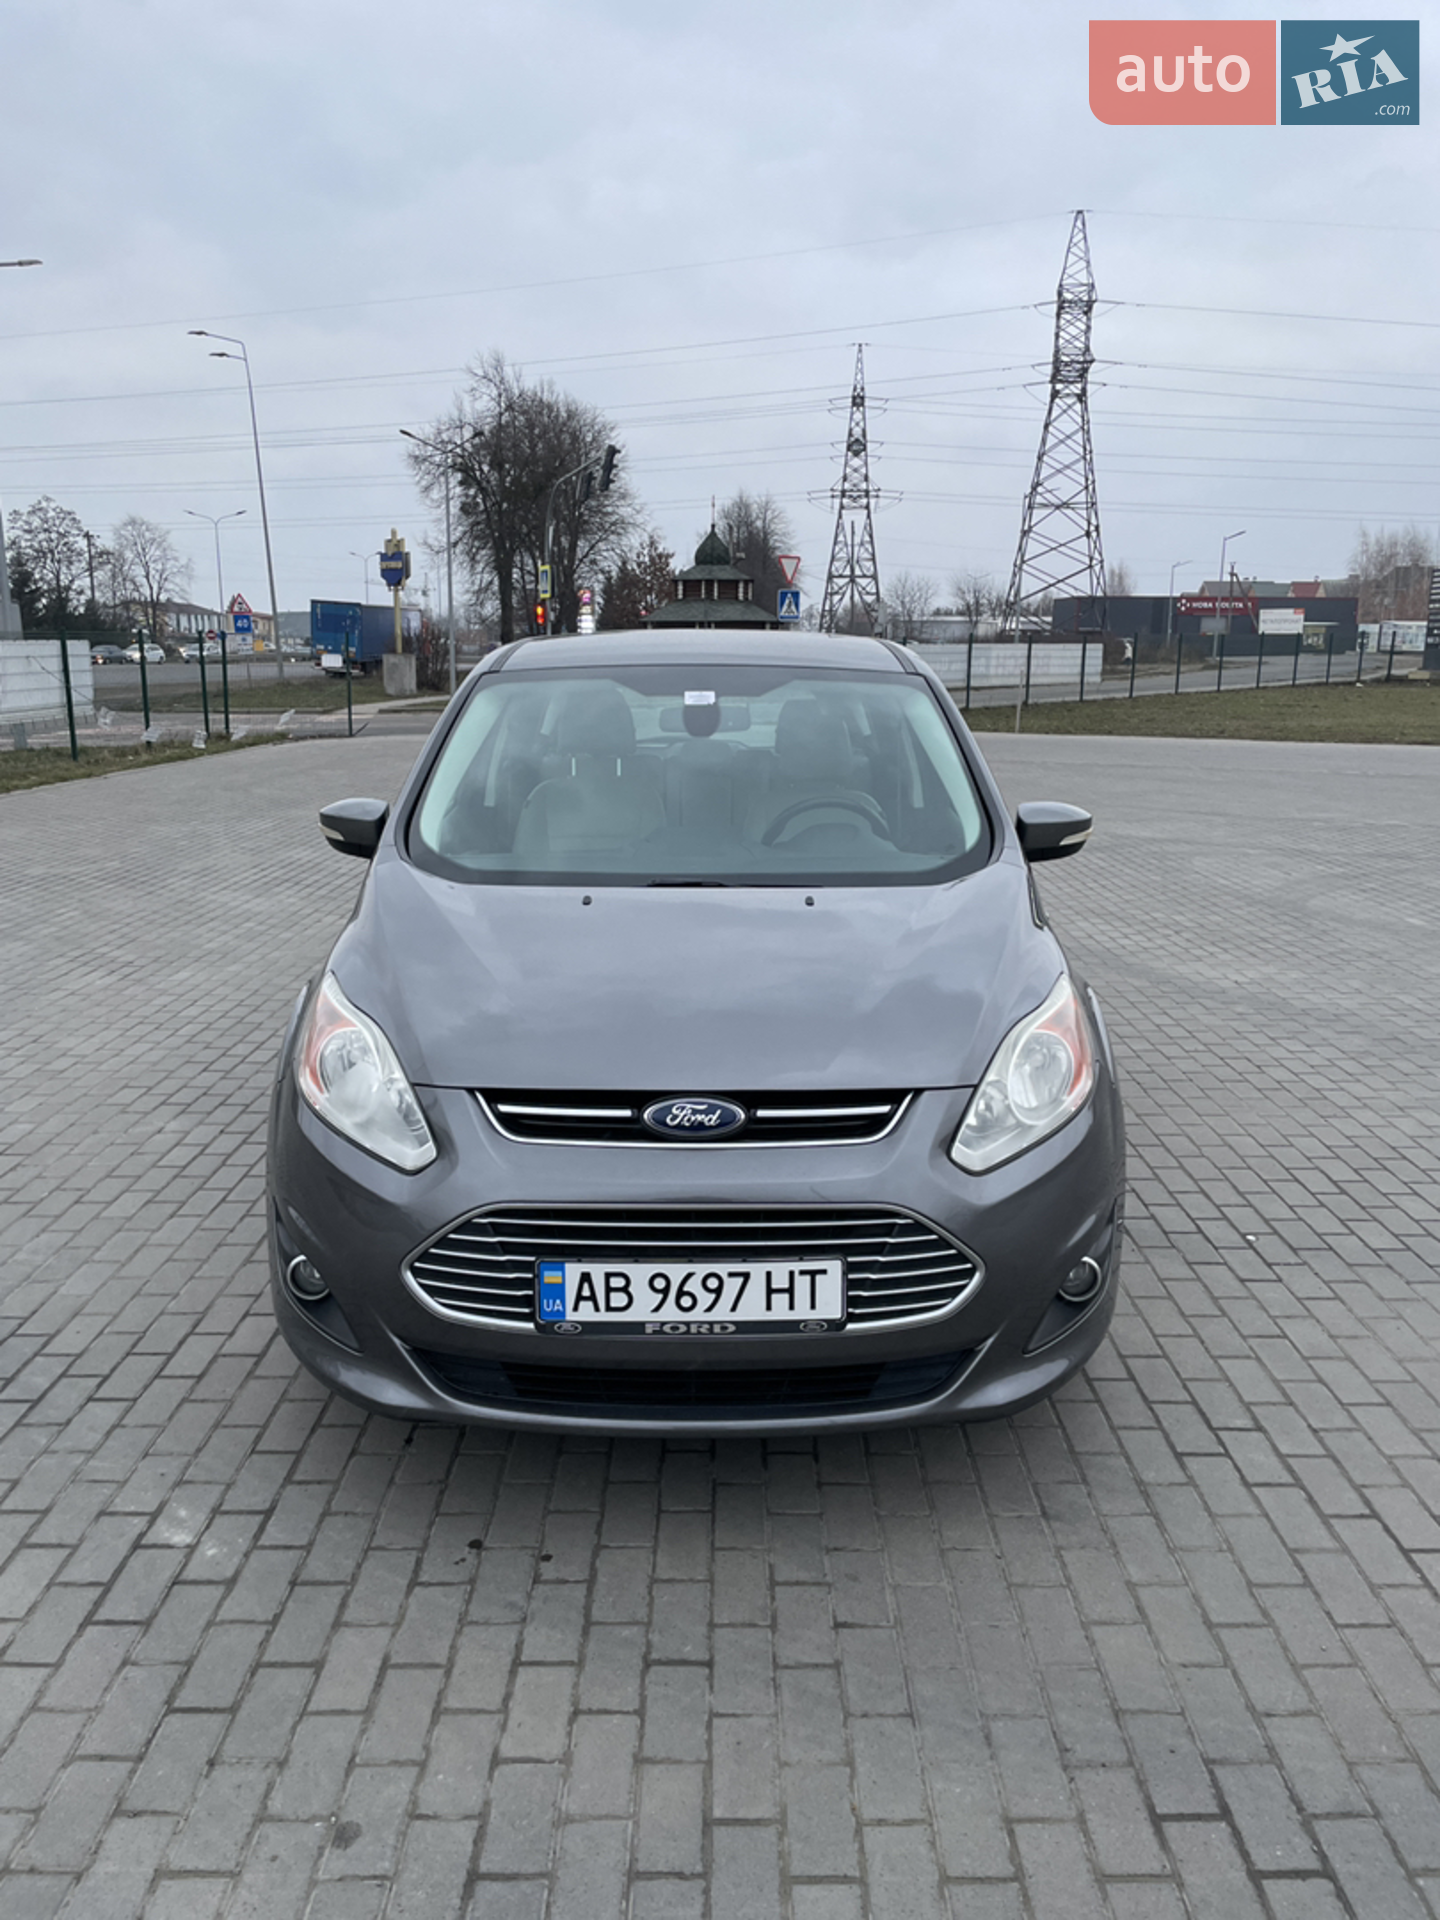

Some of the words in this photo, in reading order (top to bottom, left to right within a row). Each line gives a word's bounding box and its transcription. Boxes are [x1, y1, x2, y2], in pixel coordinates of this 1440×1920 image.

[665, 1103, 722, 1127] Ford
[572, 1271, 634, 1313] AB
[648, 1271, 751, 1313] 9697
[765, 1269, 828, 1311] HT
[543, 1298, 564, 1312] UA
[645, 1322, 737, 1334] FORD
